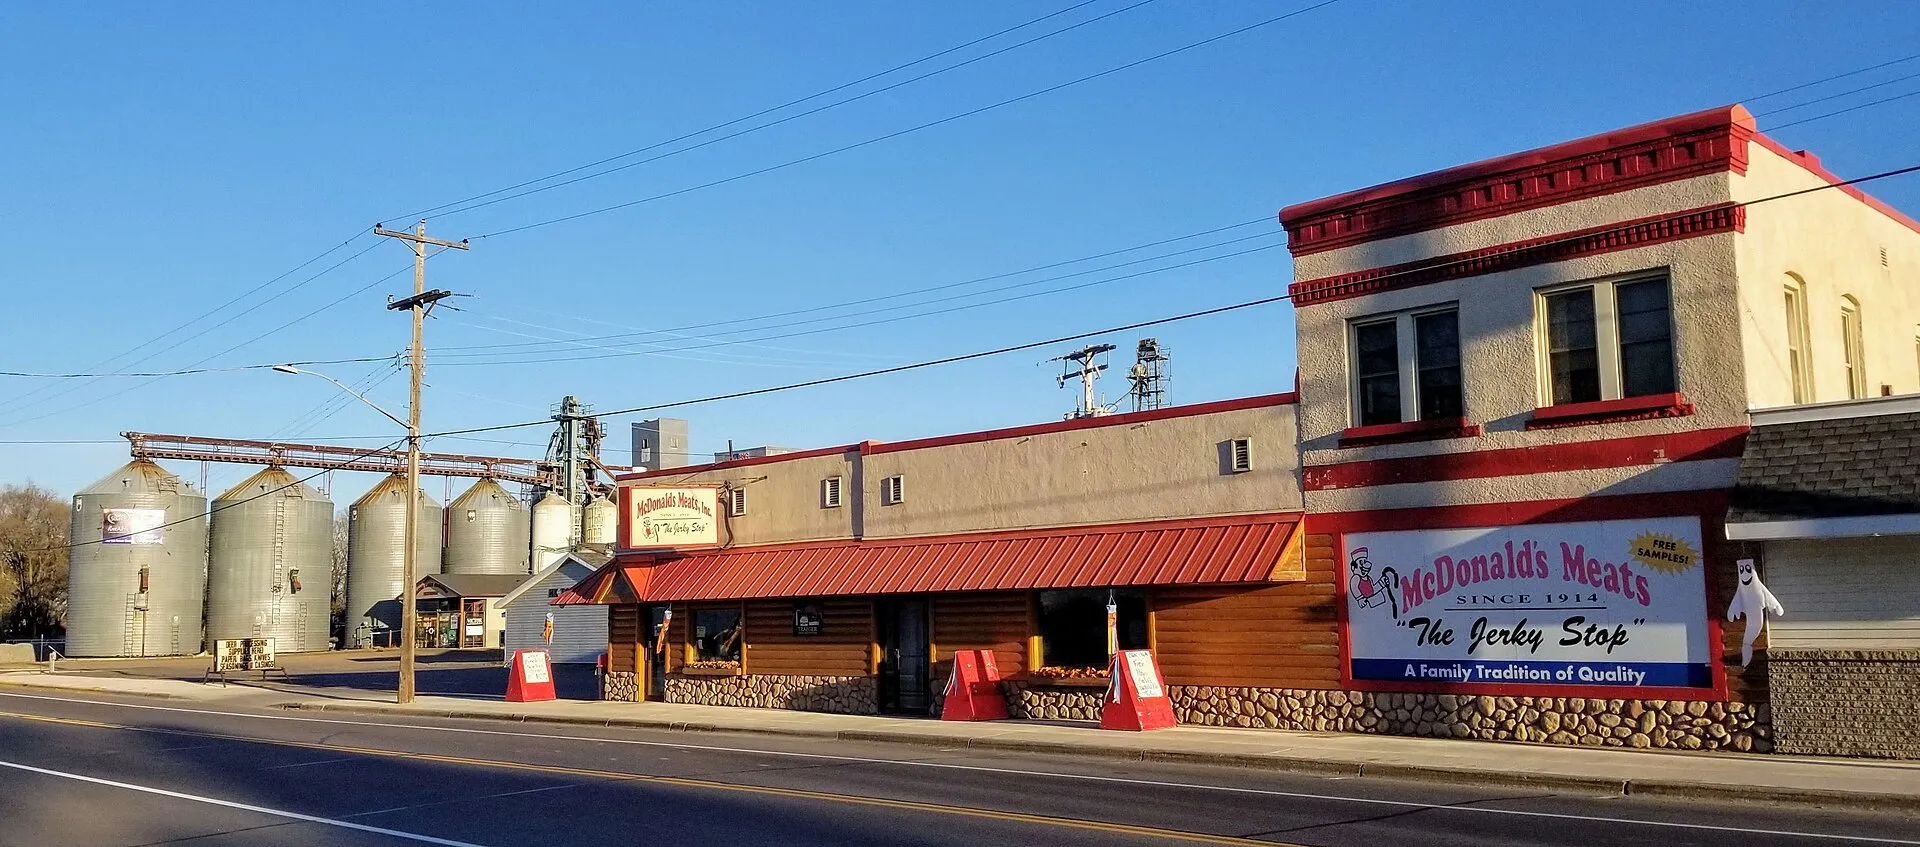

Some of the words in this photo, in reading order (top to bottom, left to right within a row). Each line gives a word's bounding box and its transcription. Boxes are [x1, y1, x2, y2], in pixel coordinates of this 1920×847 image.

[678, 492, 700, 514] Meats,
[702, 502, 712, 517] Inc.
[673, 523, 690, 535] Jerky
[691, 522, 708, 534] Stop"
[1653, 539, 1677, 551] FREE
[1637, 548, 1689, 564] SAMPLES!
[1400, 540, 1549, 614] McDonald's
[1559, 542, 1651, 607] Meats
[1456, 594, 1532, 605] SINCE
[1396, 616, 1455, 647] "The
[1467, 616, 1544, 655] Jerky
[1558, 615, 1646, 654] Stop"
[1404, 664, 1416, 677] A
[1420, 664, 1472, 682] Family
[1475, 664, 1550, 680] Tradition
[1555, 665, 1574, 681] of
[1578, 666, 1646, 686] Quality
